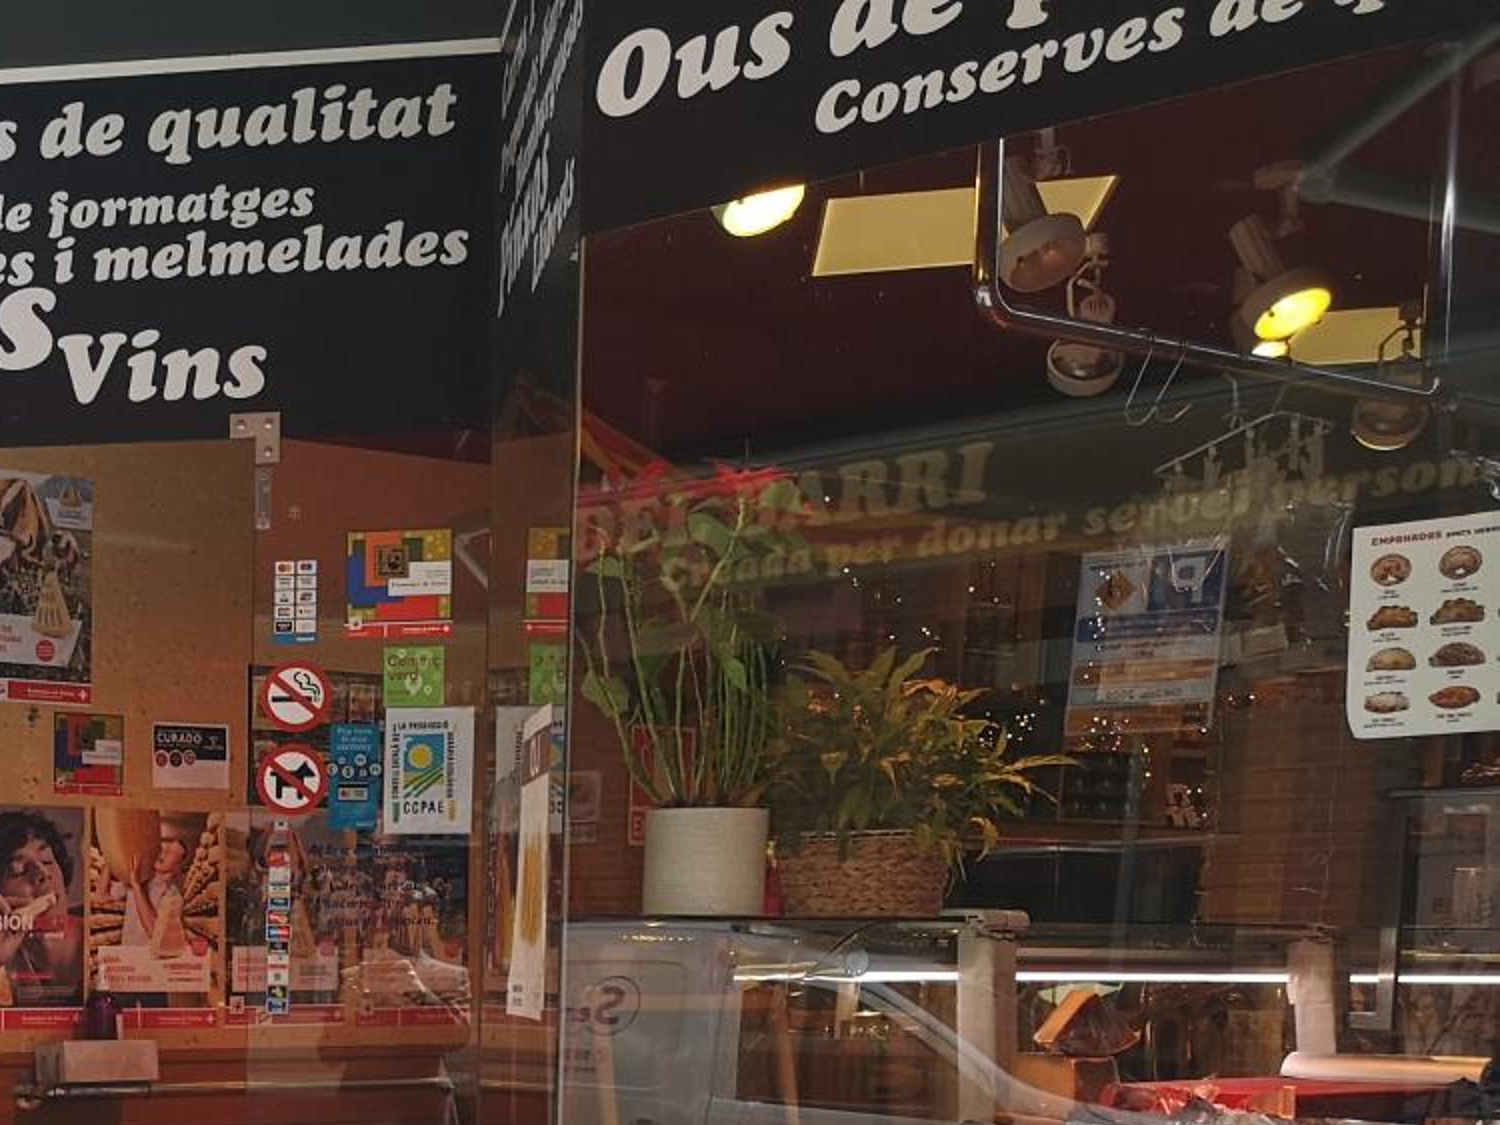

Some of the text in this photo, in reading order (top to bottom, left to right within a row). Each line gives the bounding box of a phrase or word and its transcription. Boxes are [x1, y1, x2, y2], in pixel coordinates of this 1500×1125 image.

[595, 7, 793, 118] Ous
[815, 5, 1184, 135] Conserves
[39, 101, 123, 159] de
[148, 83, 457, 165] qualitat
[47, 183, 315, 242] formatges
[55, 235, 77, 284] i
[95, 222, 470, 283] melmelades
[56, 329, 267, 405] Vins
[157, 732, 203, 743] CURADO
[403, 801, 445, 815] CCPAE
